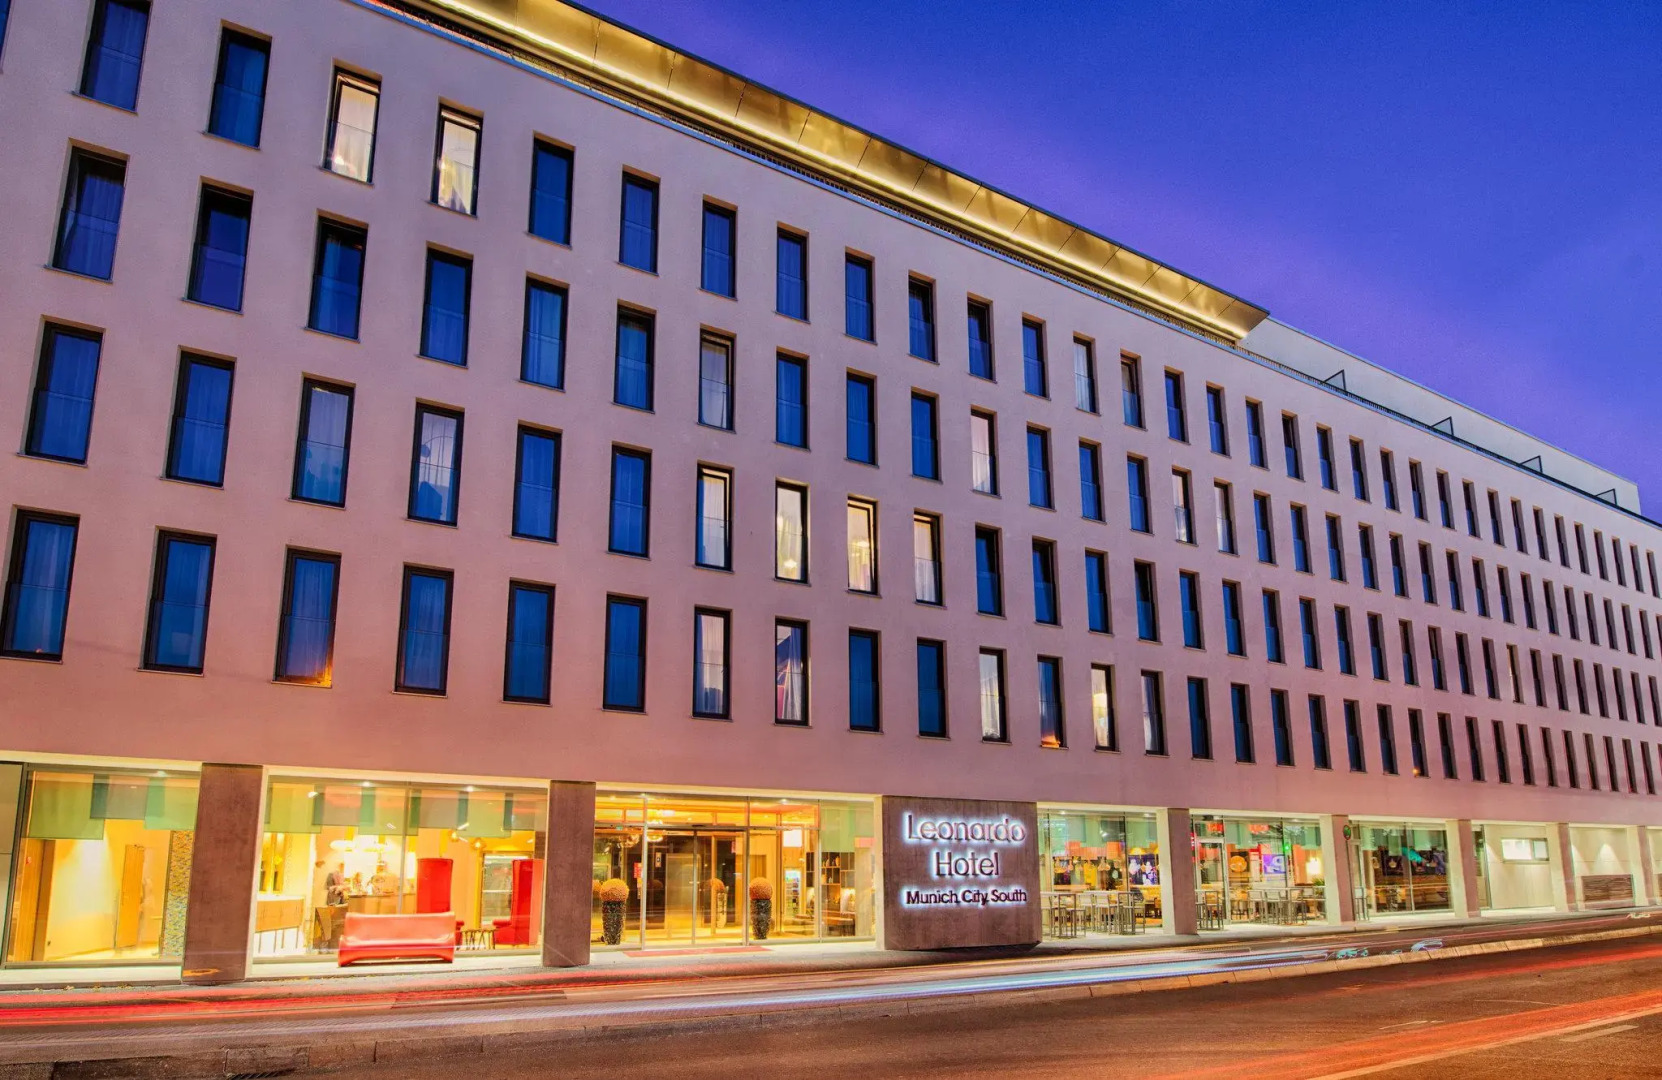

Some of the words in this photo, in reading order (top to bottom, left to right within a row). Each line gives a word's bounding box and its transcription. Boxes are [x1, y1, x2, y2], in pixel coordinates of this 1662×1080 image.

[907, 814, 1027, 843] Leonardo
[935, 851, 999, 877] Hotel
[906, 890, 959, 905] Munich
[961, 889, 988, 906] City
[990, 888, 1028, 902] South
